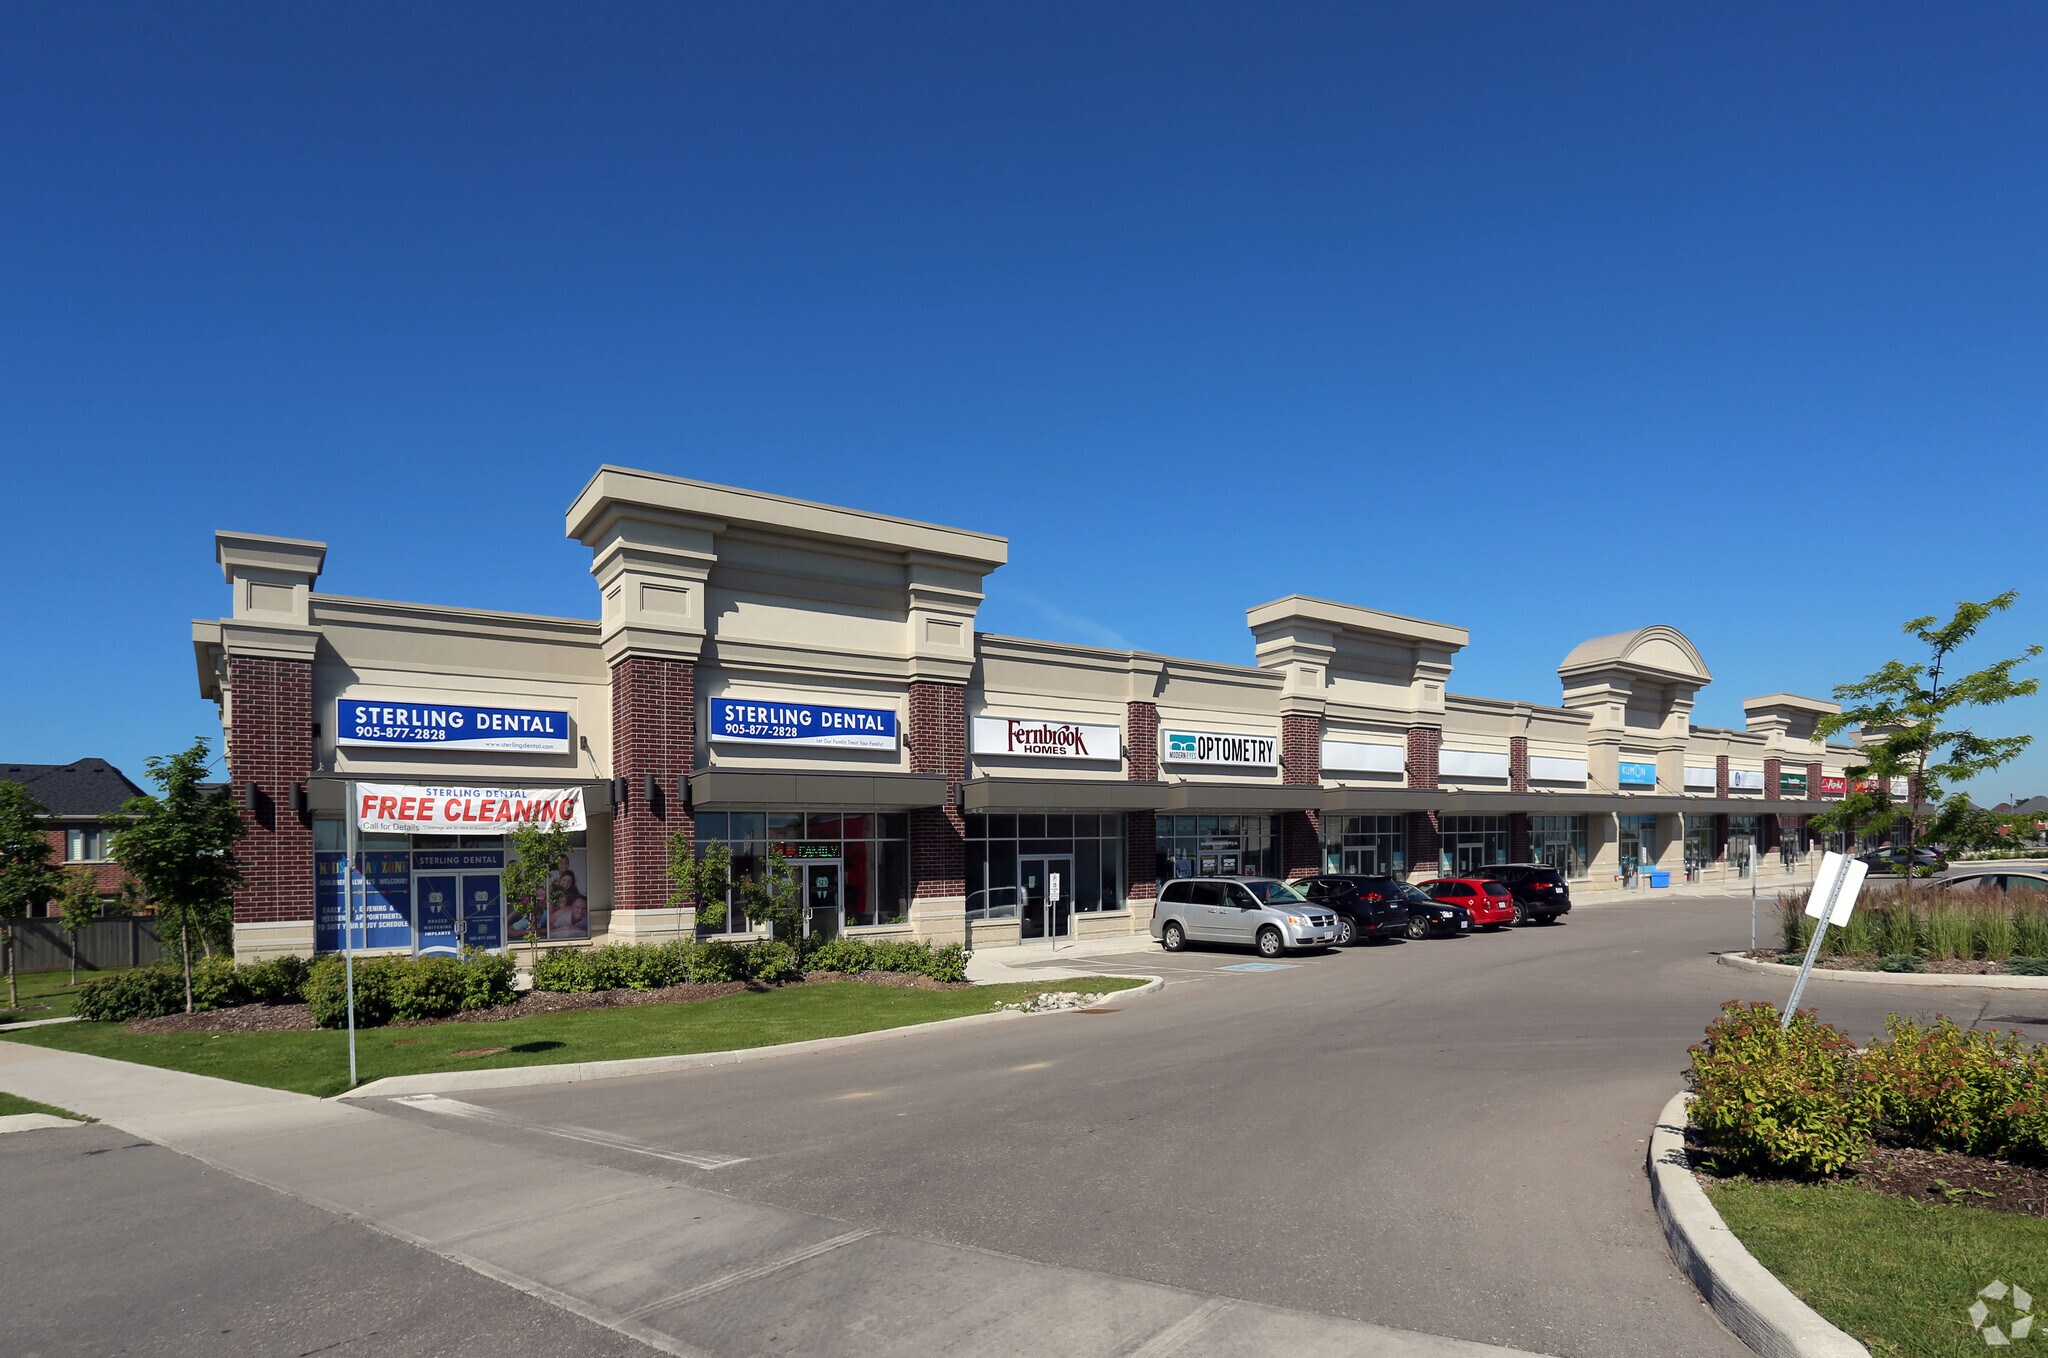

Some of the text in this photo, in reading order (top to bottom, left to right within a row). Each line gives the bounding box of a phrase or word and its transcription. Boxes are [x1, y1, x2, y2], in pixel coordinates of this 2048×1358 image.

[355, 706, 554, 733] STERLING DENTAL
[725, 705, 884, 731] STERLING DENTAL
[355, 726, 446, 740] 905-877-2828
[725, 723, 798, 737] 905-877-2828
[1008, 719, 1089, 756] Fernbrook
[485, 742, 554, 750] www.sterlingdental.com
[1024, 745, 1067, 755] HOMES
[1198, 736, 1273, 763] OPTOMETRY
[1169, 751, 1196, 760] MODERN EYES
[1622, 764, 1646, 778] KUMON
[426, 788, 527, 799] STERLING DENTAL
[361, 795, 435, 821] FREE
[363, 822, 380, 830] Call
[393, 823, 420, 832] Details
[321, 914, 346, 922] WEEKEN
